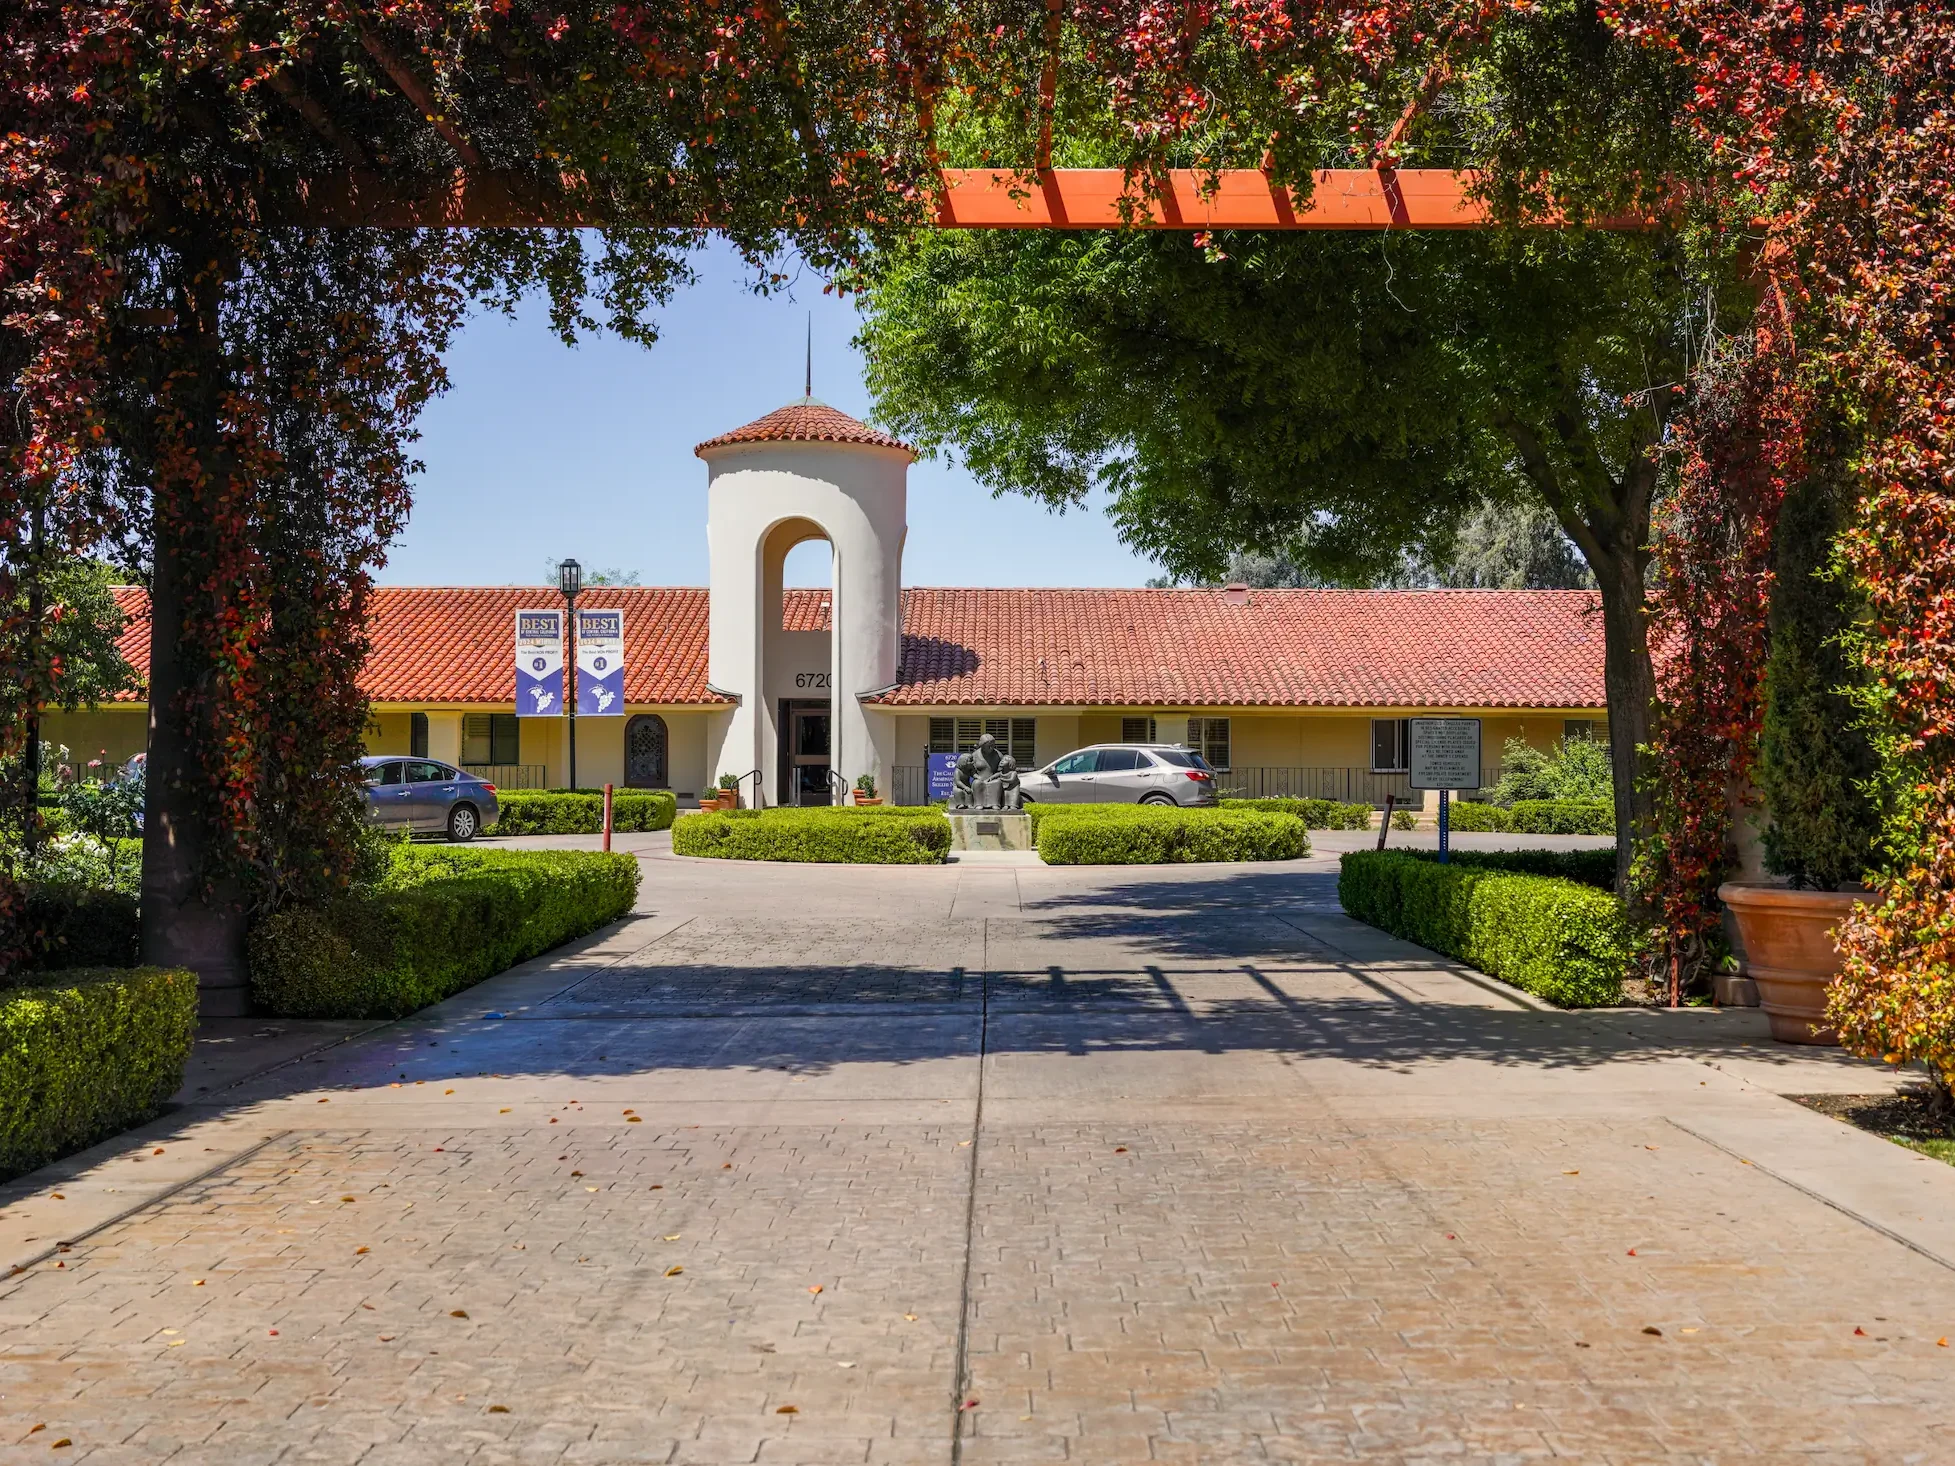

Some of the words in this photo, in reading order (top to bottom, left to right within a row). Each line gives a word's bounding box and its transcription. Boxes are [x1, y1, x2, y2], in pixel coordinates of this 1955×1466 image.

[521, 618, 557, 630] BEST
[582, 618, 618, 630] BEST
[534, 660, 542, 669] #1
[595, 660, 604, 668] #1
